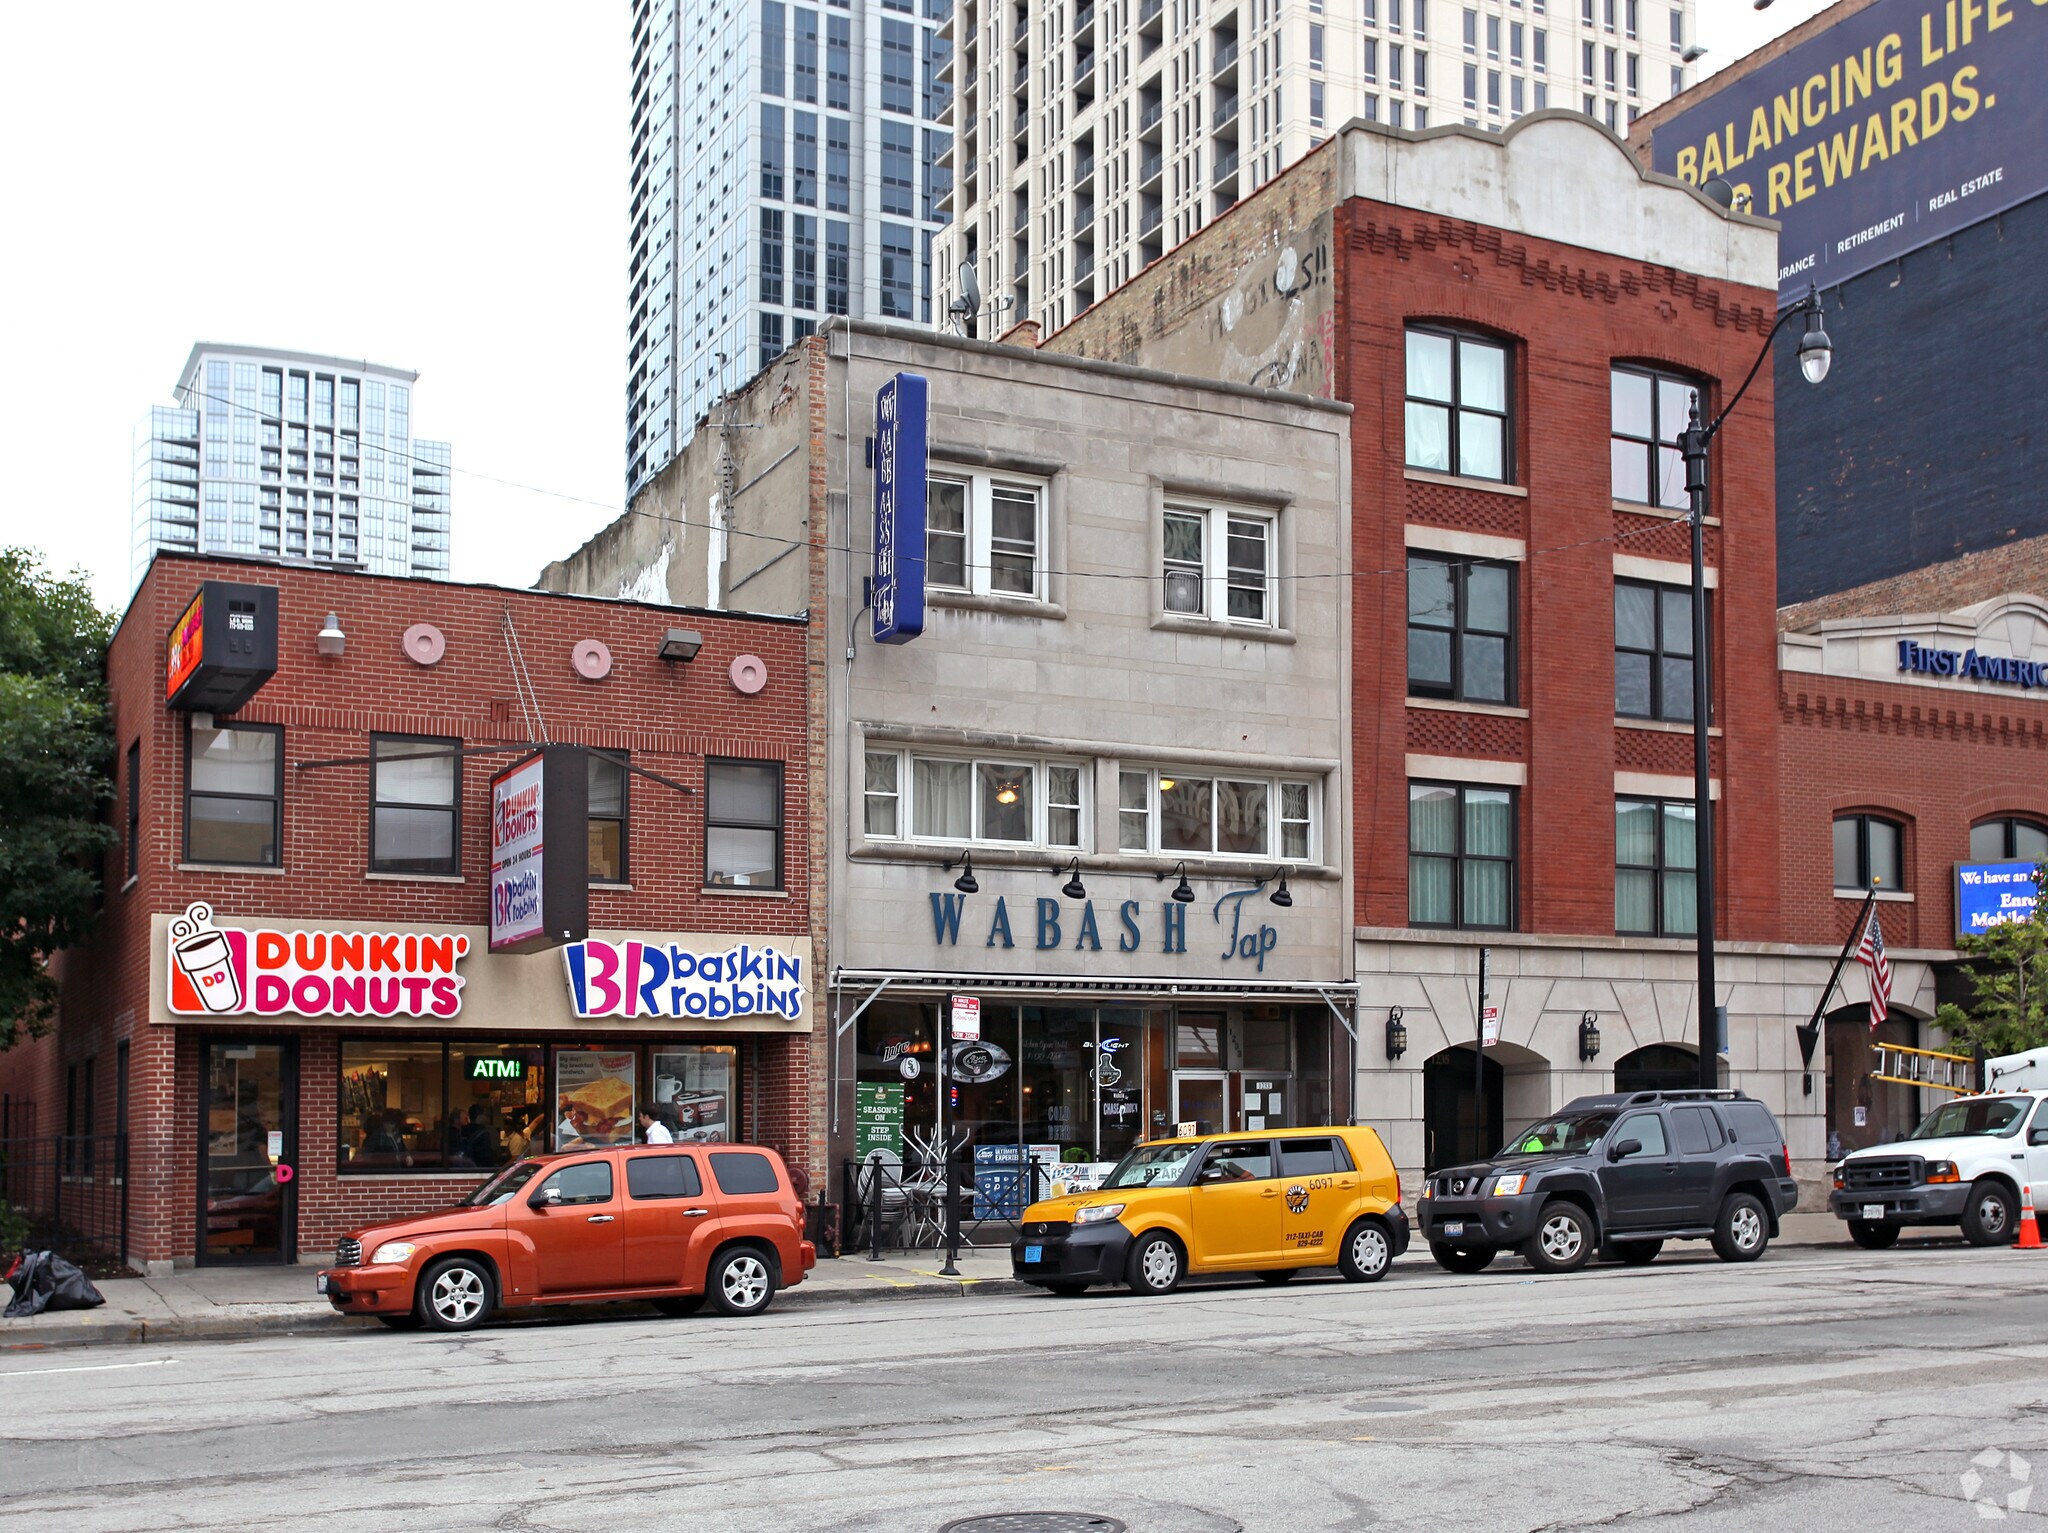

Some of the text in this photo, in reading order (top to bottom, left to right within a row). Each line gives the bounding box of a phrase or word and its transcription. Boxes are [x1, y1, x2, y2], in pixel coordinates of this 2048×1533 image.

[1676, 32, 1902, 187] BALANCING
[1768, 65, 1996, 216] REWARDS.
[1929, 167, 2004, 212] REAL ESTATE
[1837, 213, 1905, 254] RETIREMENT
[1897, 639, 1962, 676] FIRST
[505, 782, 541, 818] DUNKIN'
[505, 809, 537, 843] DONUTS
[518, 848, 532, 864] HOURS
[512, 869, 537, 897] baskin
[1960, 872, 1981, 885] We
[1983, 870, 2010, 884] have
[2012, 872, 2028, 882] an
[512, 895, 538, 922] robbins
[929, 881, 1278, 973] WABASH Tap
[256, 932, 467, 974] DUNKIN'
[670, 945, 800, 984] baskin
[201, 971, 226, 988] DD
[255, 974, 459, 1016] DONUTS
[671, 982, 801, 1018] robbins
[473, 1060, 515, 1078] ATM
[863, 1106, 898, 1114] SEASON'S
[867, 1134, 892, 1142] INSIDE
[1178, 1124, 1196, 1136] 6097
[1309, 1177, 1333, 1190] 6097
